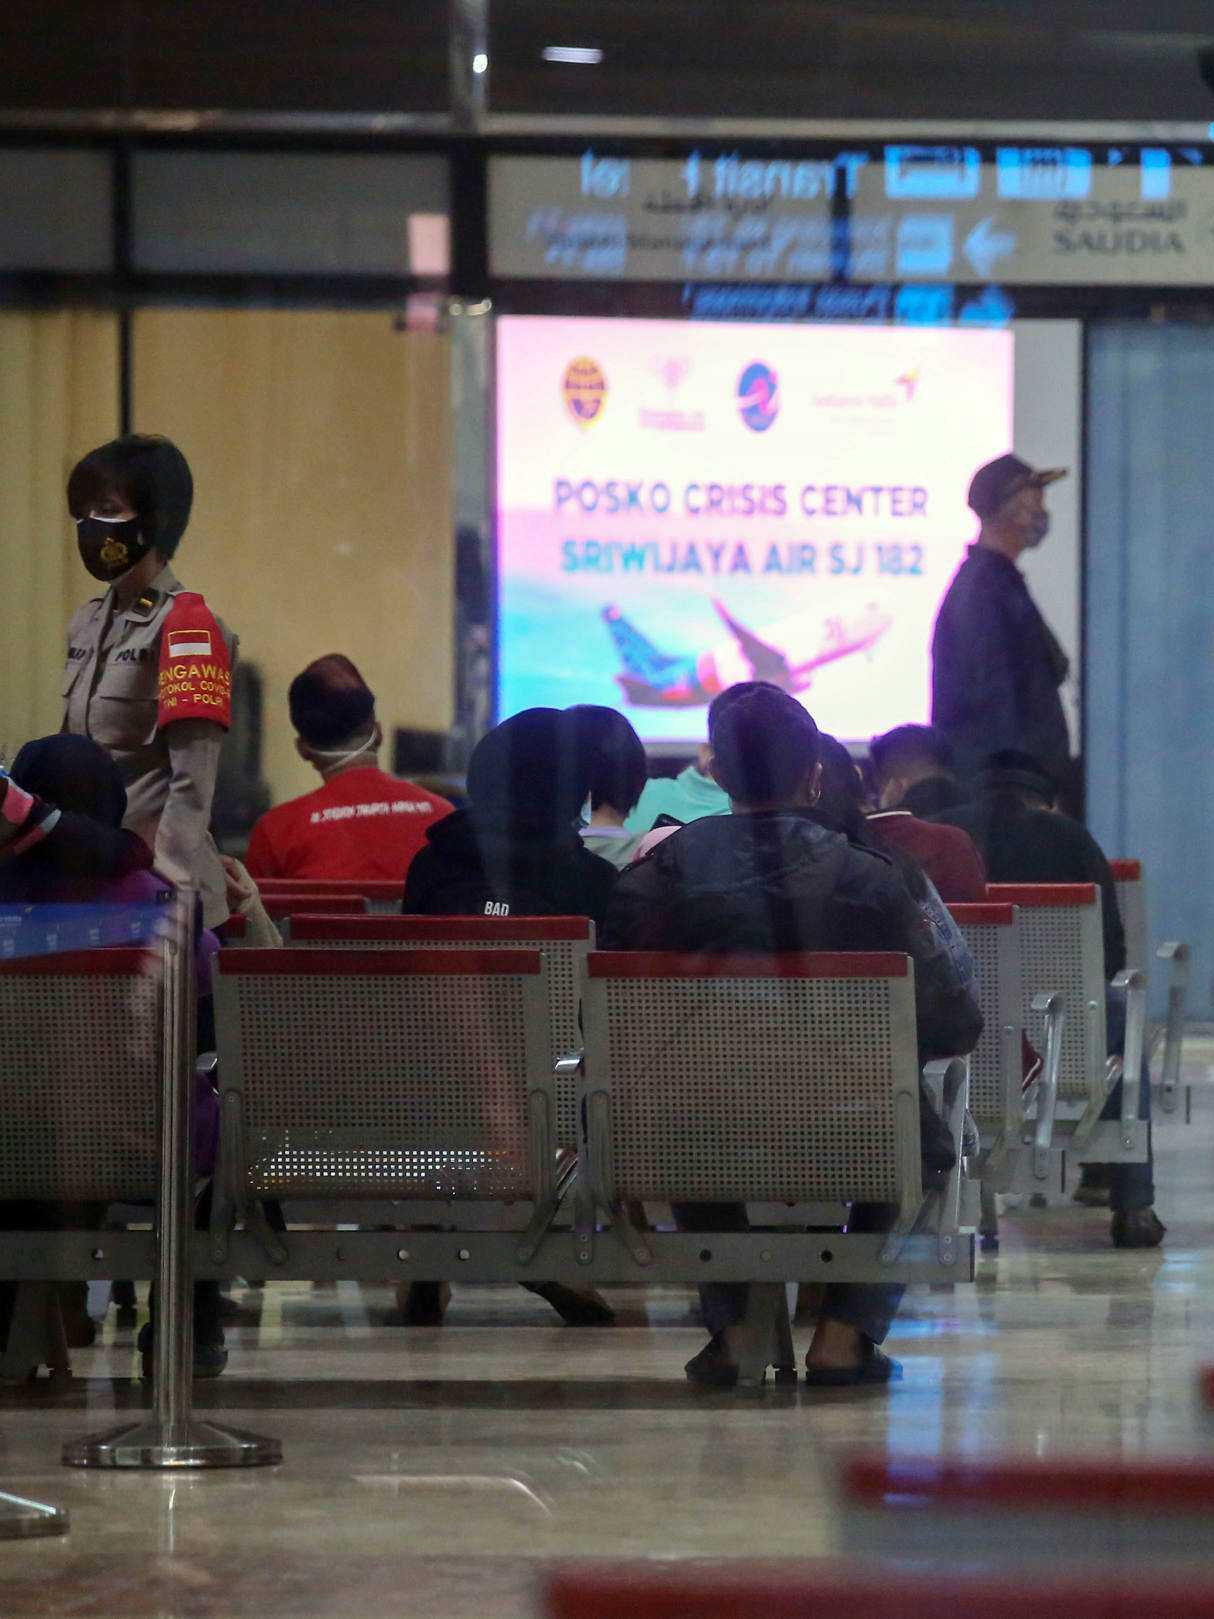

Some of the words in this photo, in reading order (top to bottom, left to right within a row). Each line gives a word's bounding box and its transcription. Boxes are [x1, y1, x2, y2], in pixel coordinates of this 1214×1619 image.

[1053, 229, 1186, 254] SAUDIA
[555, 479, 671, 513] POSKO
[684, 482, 787, 516] CRISIS
[801, 484, 928, 517] CENTER
[561, 539, 752, 574] SRIWIJAYA
[763, 542, 817, 574] AIR
[829, 542, 864, 575] SJ
[876, 544, 923, 576] 182
[158, 664, 231, 686] ENGAWAS
[484, 900, 510, 917] BAD
